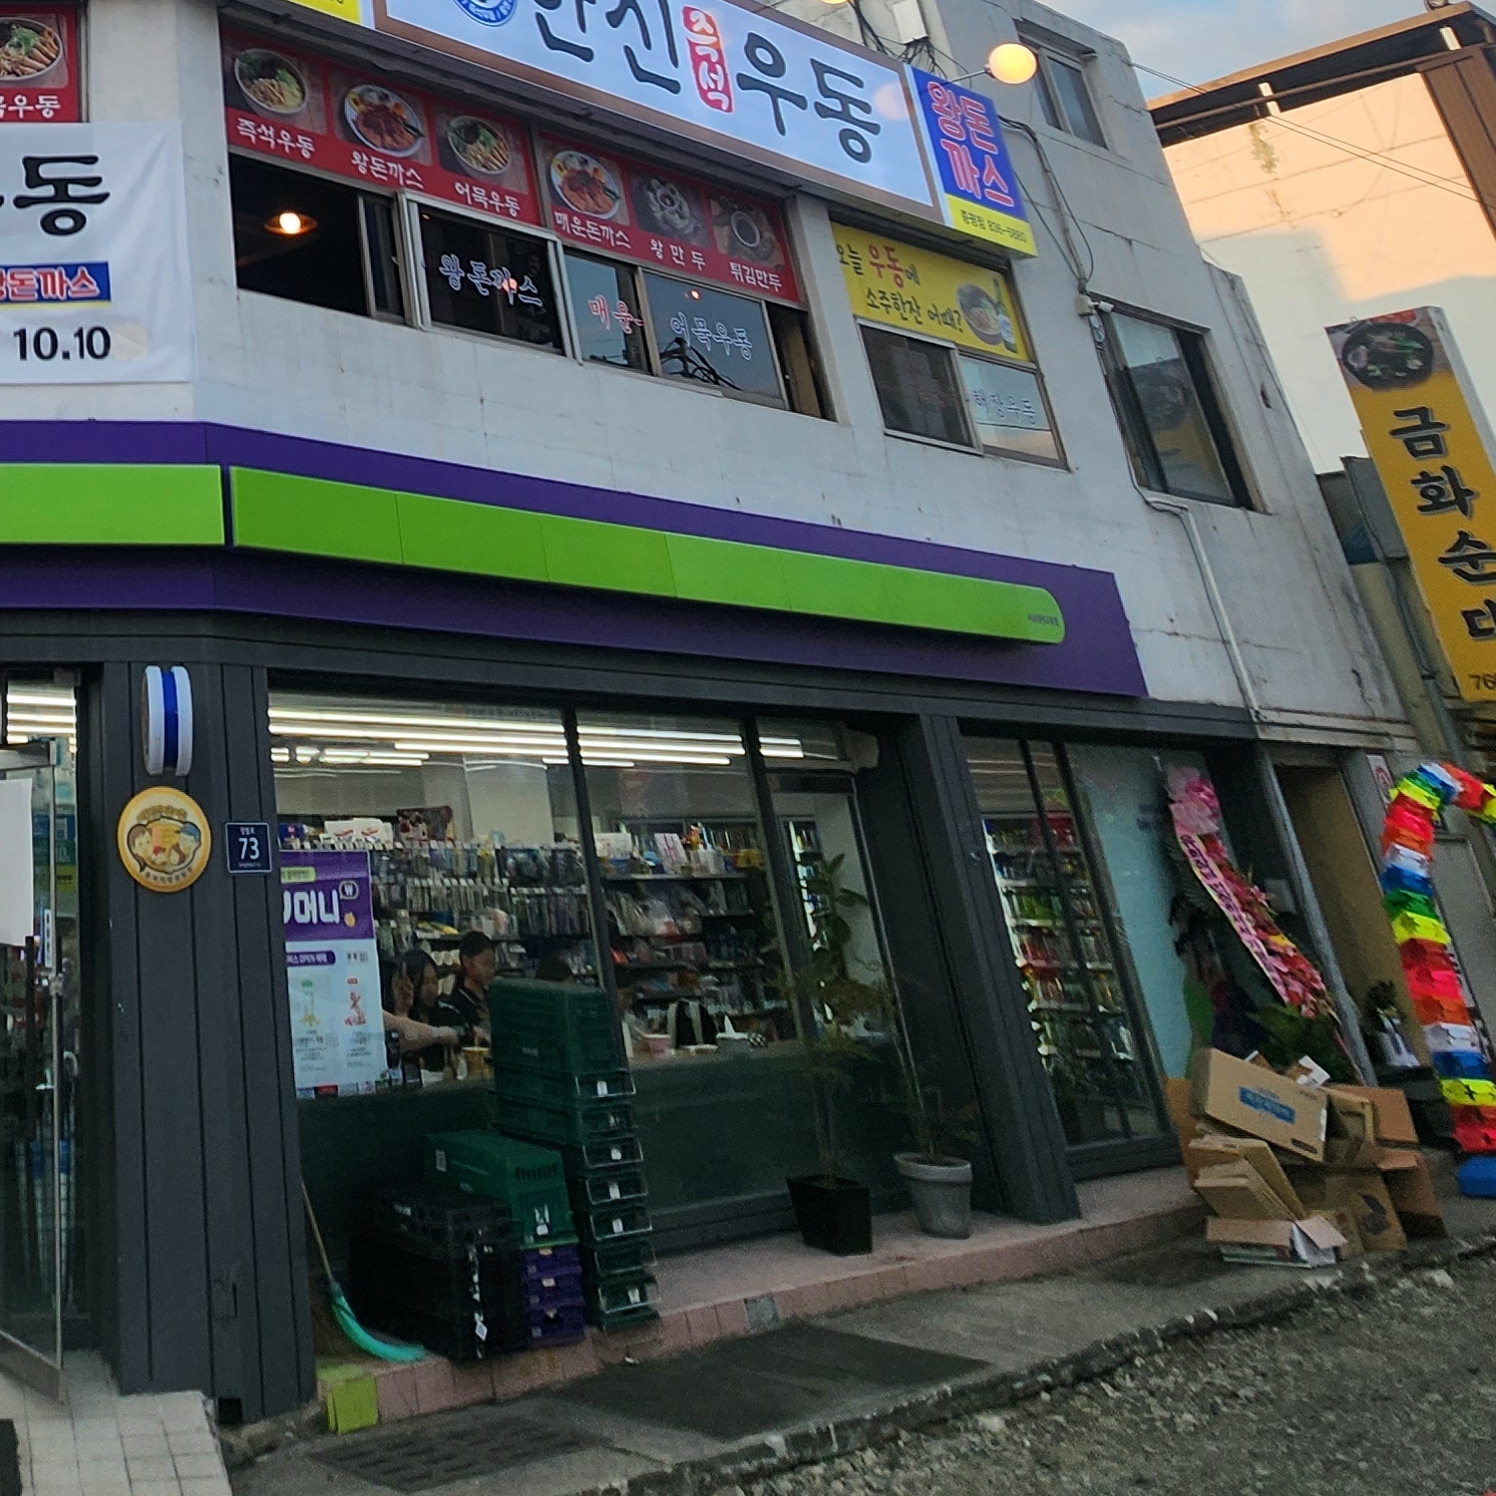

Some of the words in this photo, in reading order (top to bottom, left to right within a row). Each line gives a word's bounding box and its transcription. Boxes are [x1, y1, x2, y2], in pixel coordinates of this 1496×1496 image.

[684, 7, 731, 112] 즉석
[736, 31, 882, 164] 우동
[237, 117, 316, 160] 즉석우동
[926, 81, 998, 155] 왕돈
[350, 150, 424, 192] 왕돈까스
[940, 143, 1015, 209] 까스
[454, 180, 520, 218] 어묵우동
[554, 209, 631, 250] 매운돈까스
[438, 252, 543, 308] 왕돈까스
[729, 259, 782, 294] 튀김만두
[836, 244, 864, 276] 오늘
[869, 244, 921, 289] 우동에
[588, 293, 644, 335] 매운
[12, 325, 112, 361] 10.10
[670, 311, 753, 362] 어묵우동
[238, 837, 260, 860] 73
